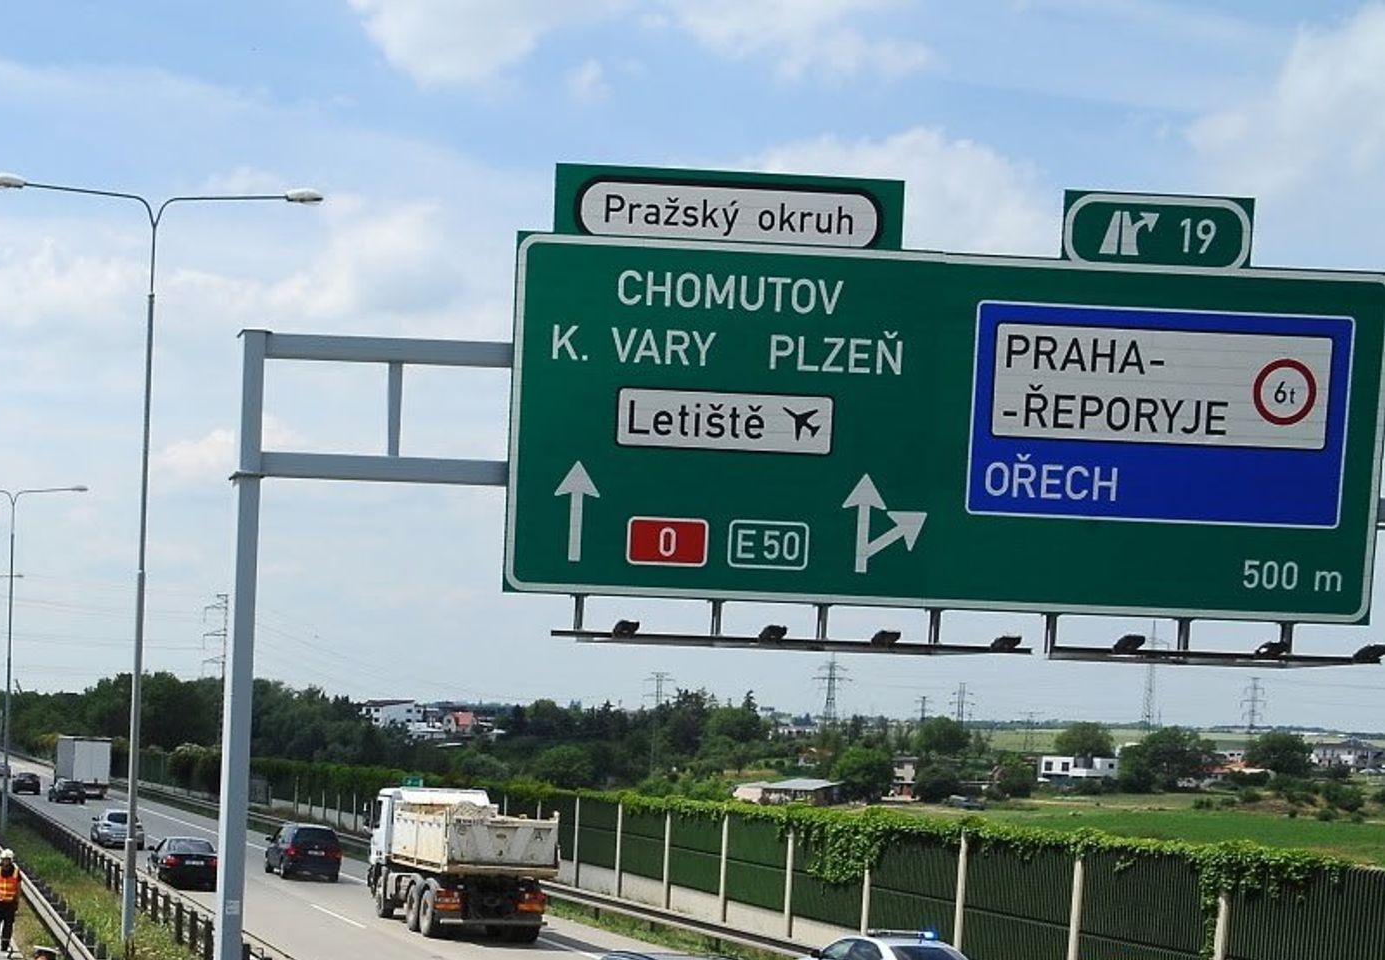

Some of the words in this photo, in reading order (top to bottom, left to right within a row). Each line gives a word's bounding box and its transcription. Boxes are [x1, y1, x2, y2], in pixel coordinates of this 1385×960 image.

[603, 193, 740, 238] Pražský
[758, 203, 854, 236] okruh
[1179, 217, 1217, 255] 19
[617, 270, 844, 315] CHOMUTOV
[551, 324, 589, 361] K.
[611, 326, 716, 366] VARY
[768, 331, 904, 376] PLZEŇ
[1005, 334, 1165, 375] PRAHA-
[627, 399, 765, 440] Letiště
[1002, 384, 1229, 436] -ŘEPORYJE
[983, 453, 1118, 502] OŘECH
[1242, 560, 1299, 591] 500
[1314, 570, 1343, 592] m
